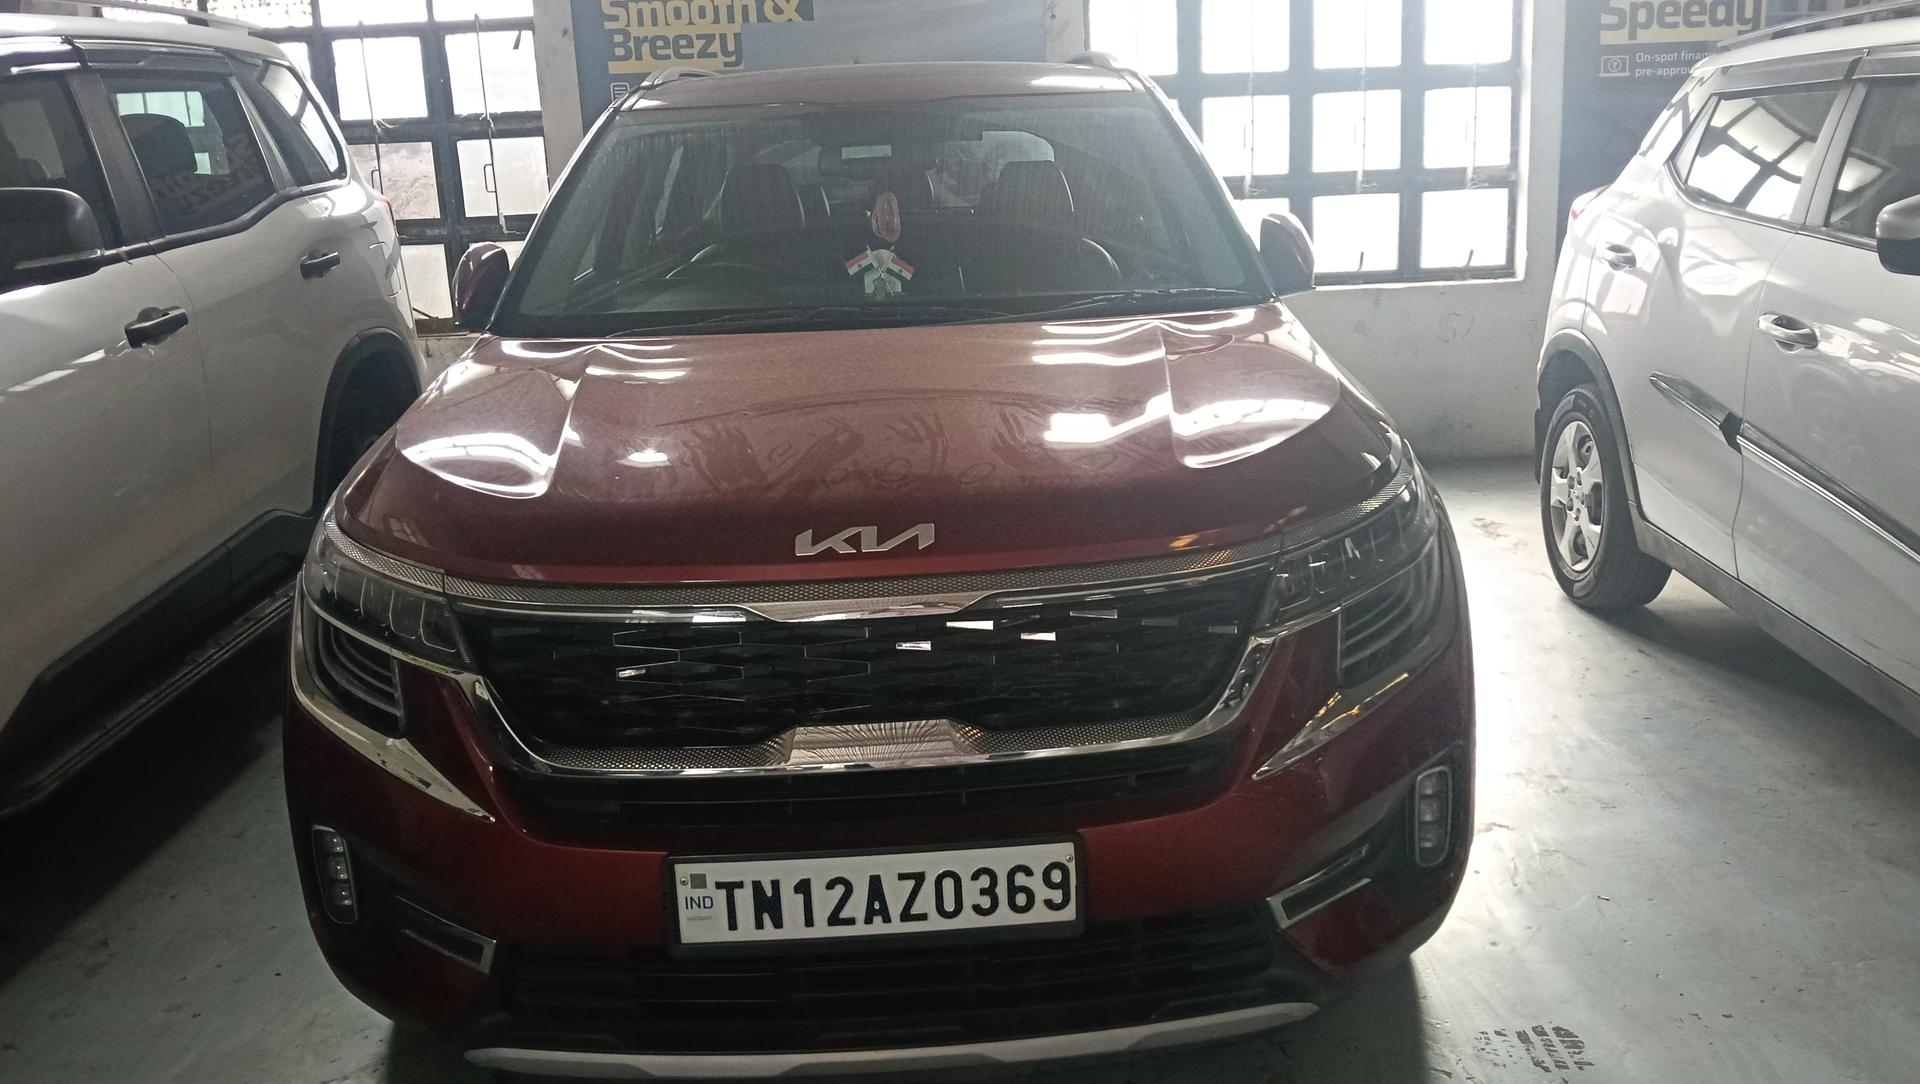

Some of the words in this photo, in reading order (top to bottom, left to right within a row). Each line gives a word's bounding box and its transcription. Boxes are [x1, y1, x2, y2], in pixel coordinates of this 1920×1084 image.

[601, 0, 757, 29] Smooth
[763, 0, 803, 23] &
[1600, 0, 1762, 41] Speedy
[608, 28, 744, 68] Breezy
[1635, 52, 1678, 63] On-spot
[1681, 50, 1712, 60] finan
[795, 522, 935, 556] KIA
[684, 895, 714, 910] IND
[715, 861, 1071, 931] TN12AZ0369
